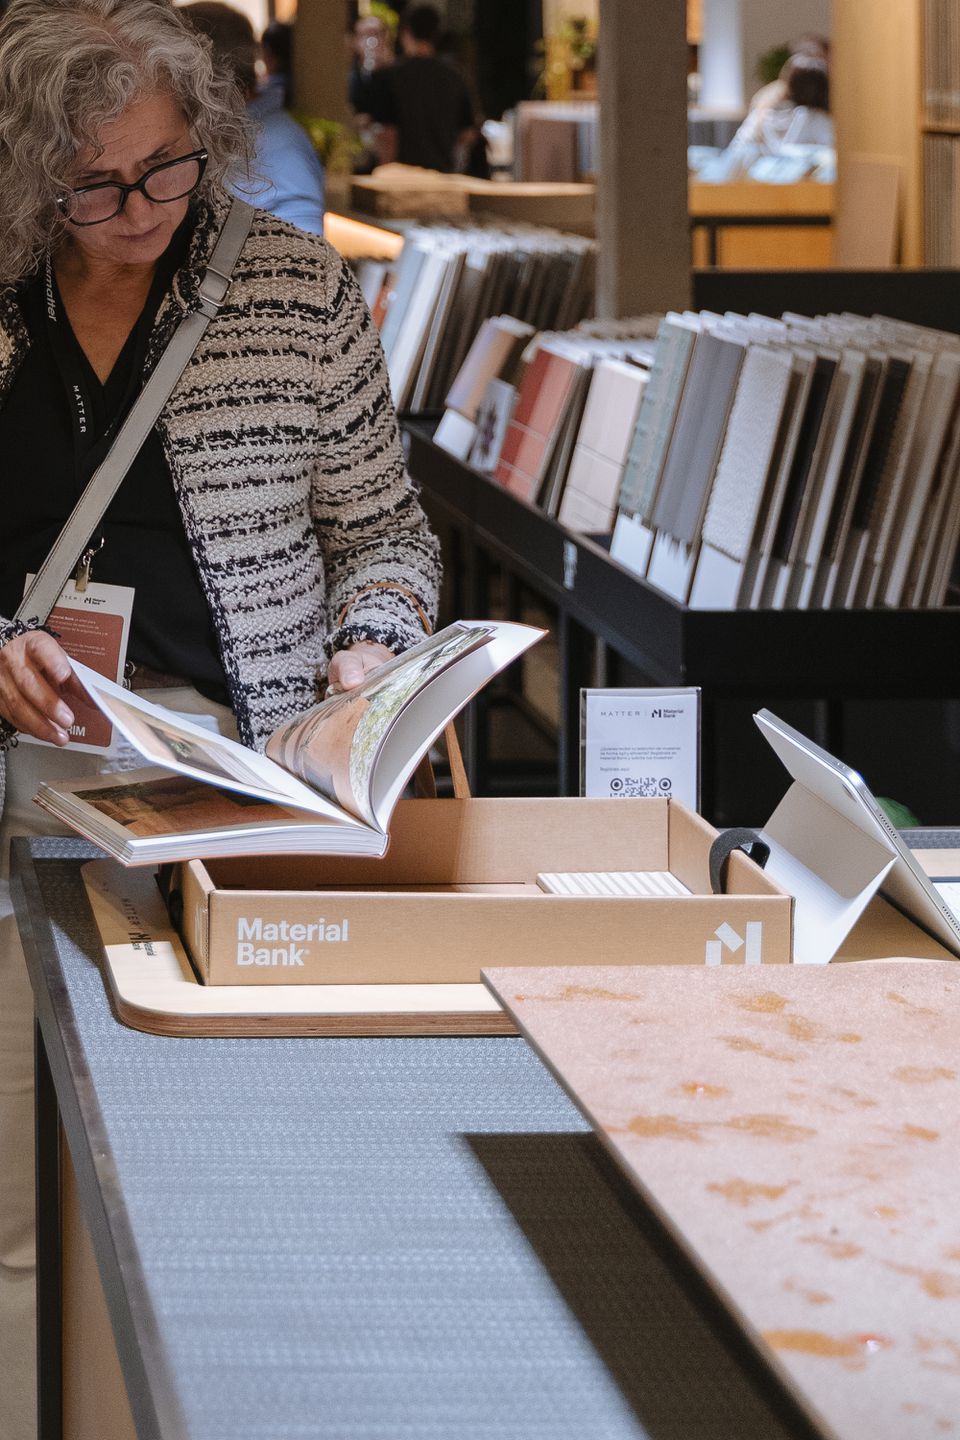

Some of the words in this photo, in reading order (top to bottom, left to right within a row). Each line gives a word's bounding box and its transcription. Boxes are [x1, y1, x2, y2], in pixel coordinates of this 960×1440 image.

[44, 253, 57, 322] alsmatter
[73, 385, 87, 433] MATTER
[67, 726, 85, 736] RIM
[238, 917, 349, 941] Material
[237, 942, 305, 966] Bank
